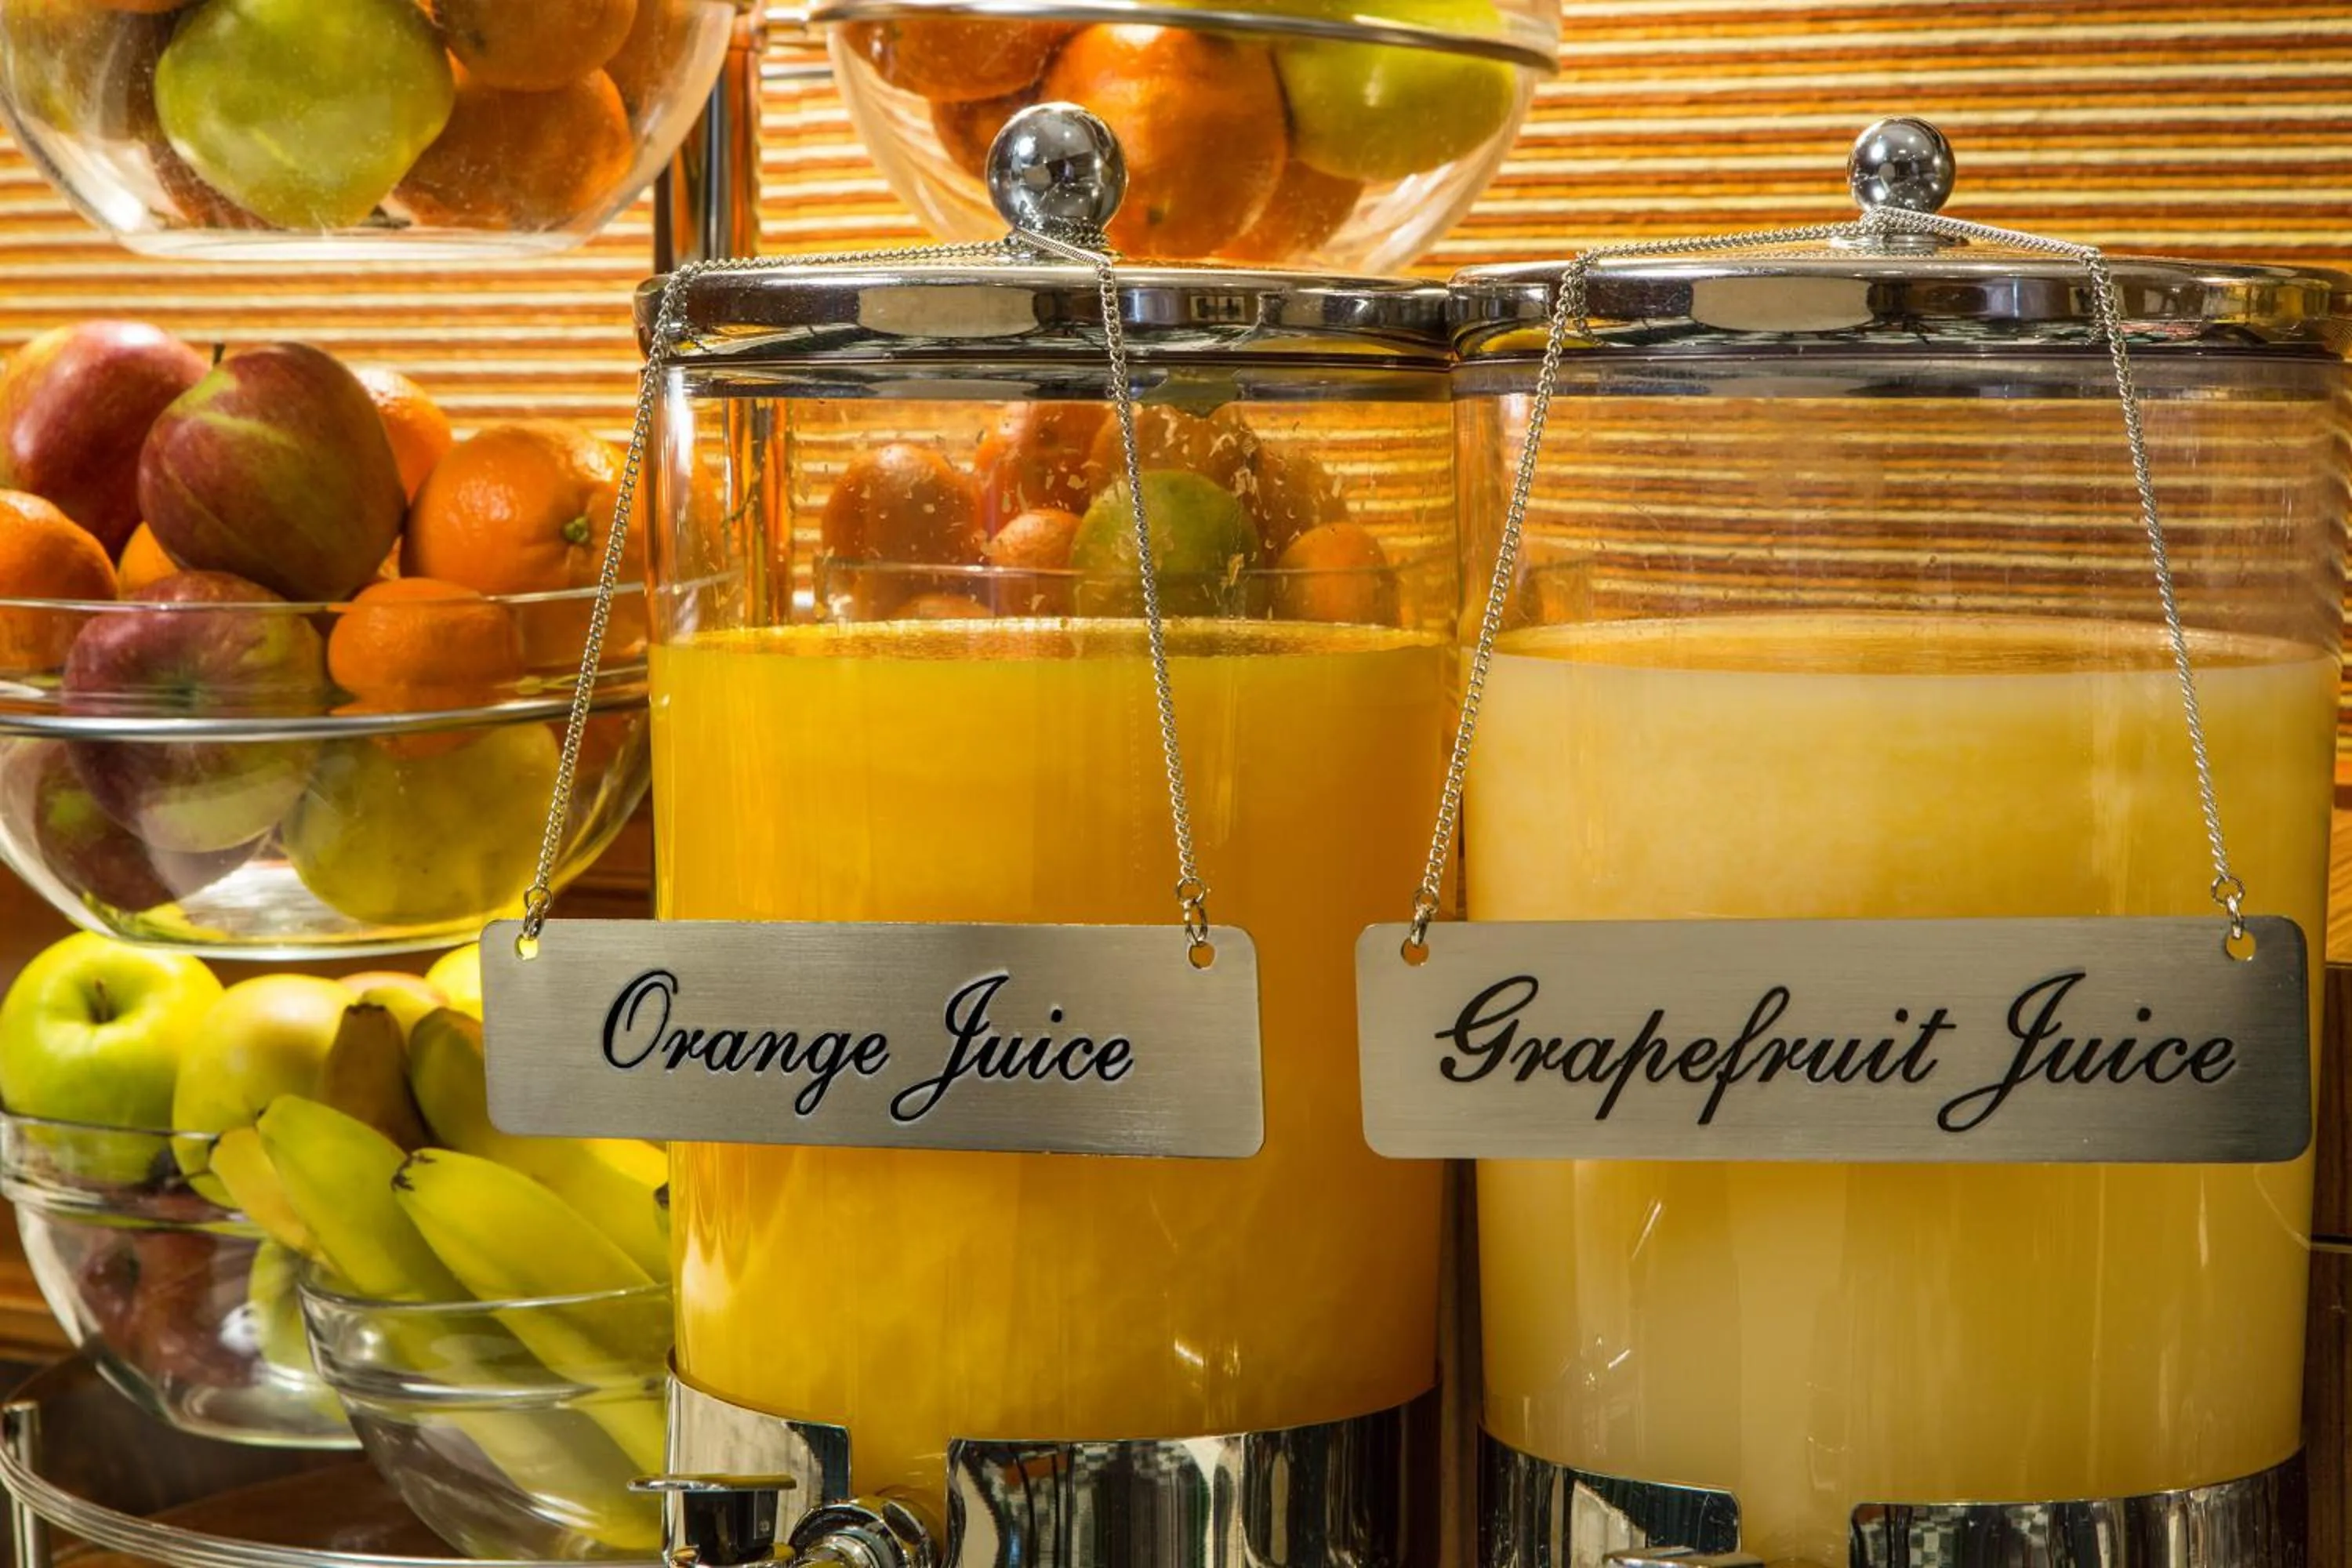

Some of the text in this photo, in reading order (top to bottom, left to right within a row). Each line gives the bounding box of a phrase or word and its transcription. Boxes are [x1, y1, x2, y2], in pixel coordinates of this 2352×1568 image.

[602, 969, 1134, 1123] Orange Juice
[1435, 972, 2237, 1133] Grapefruit Juice
